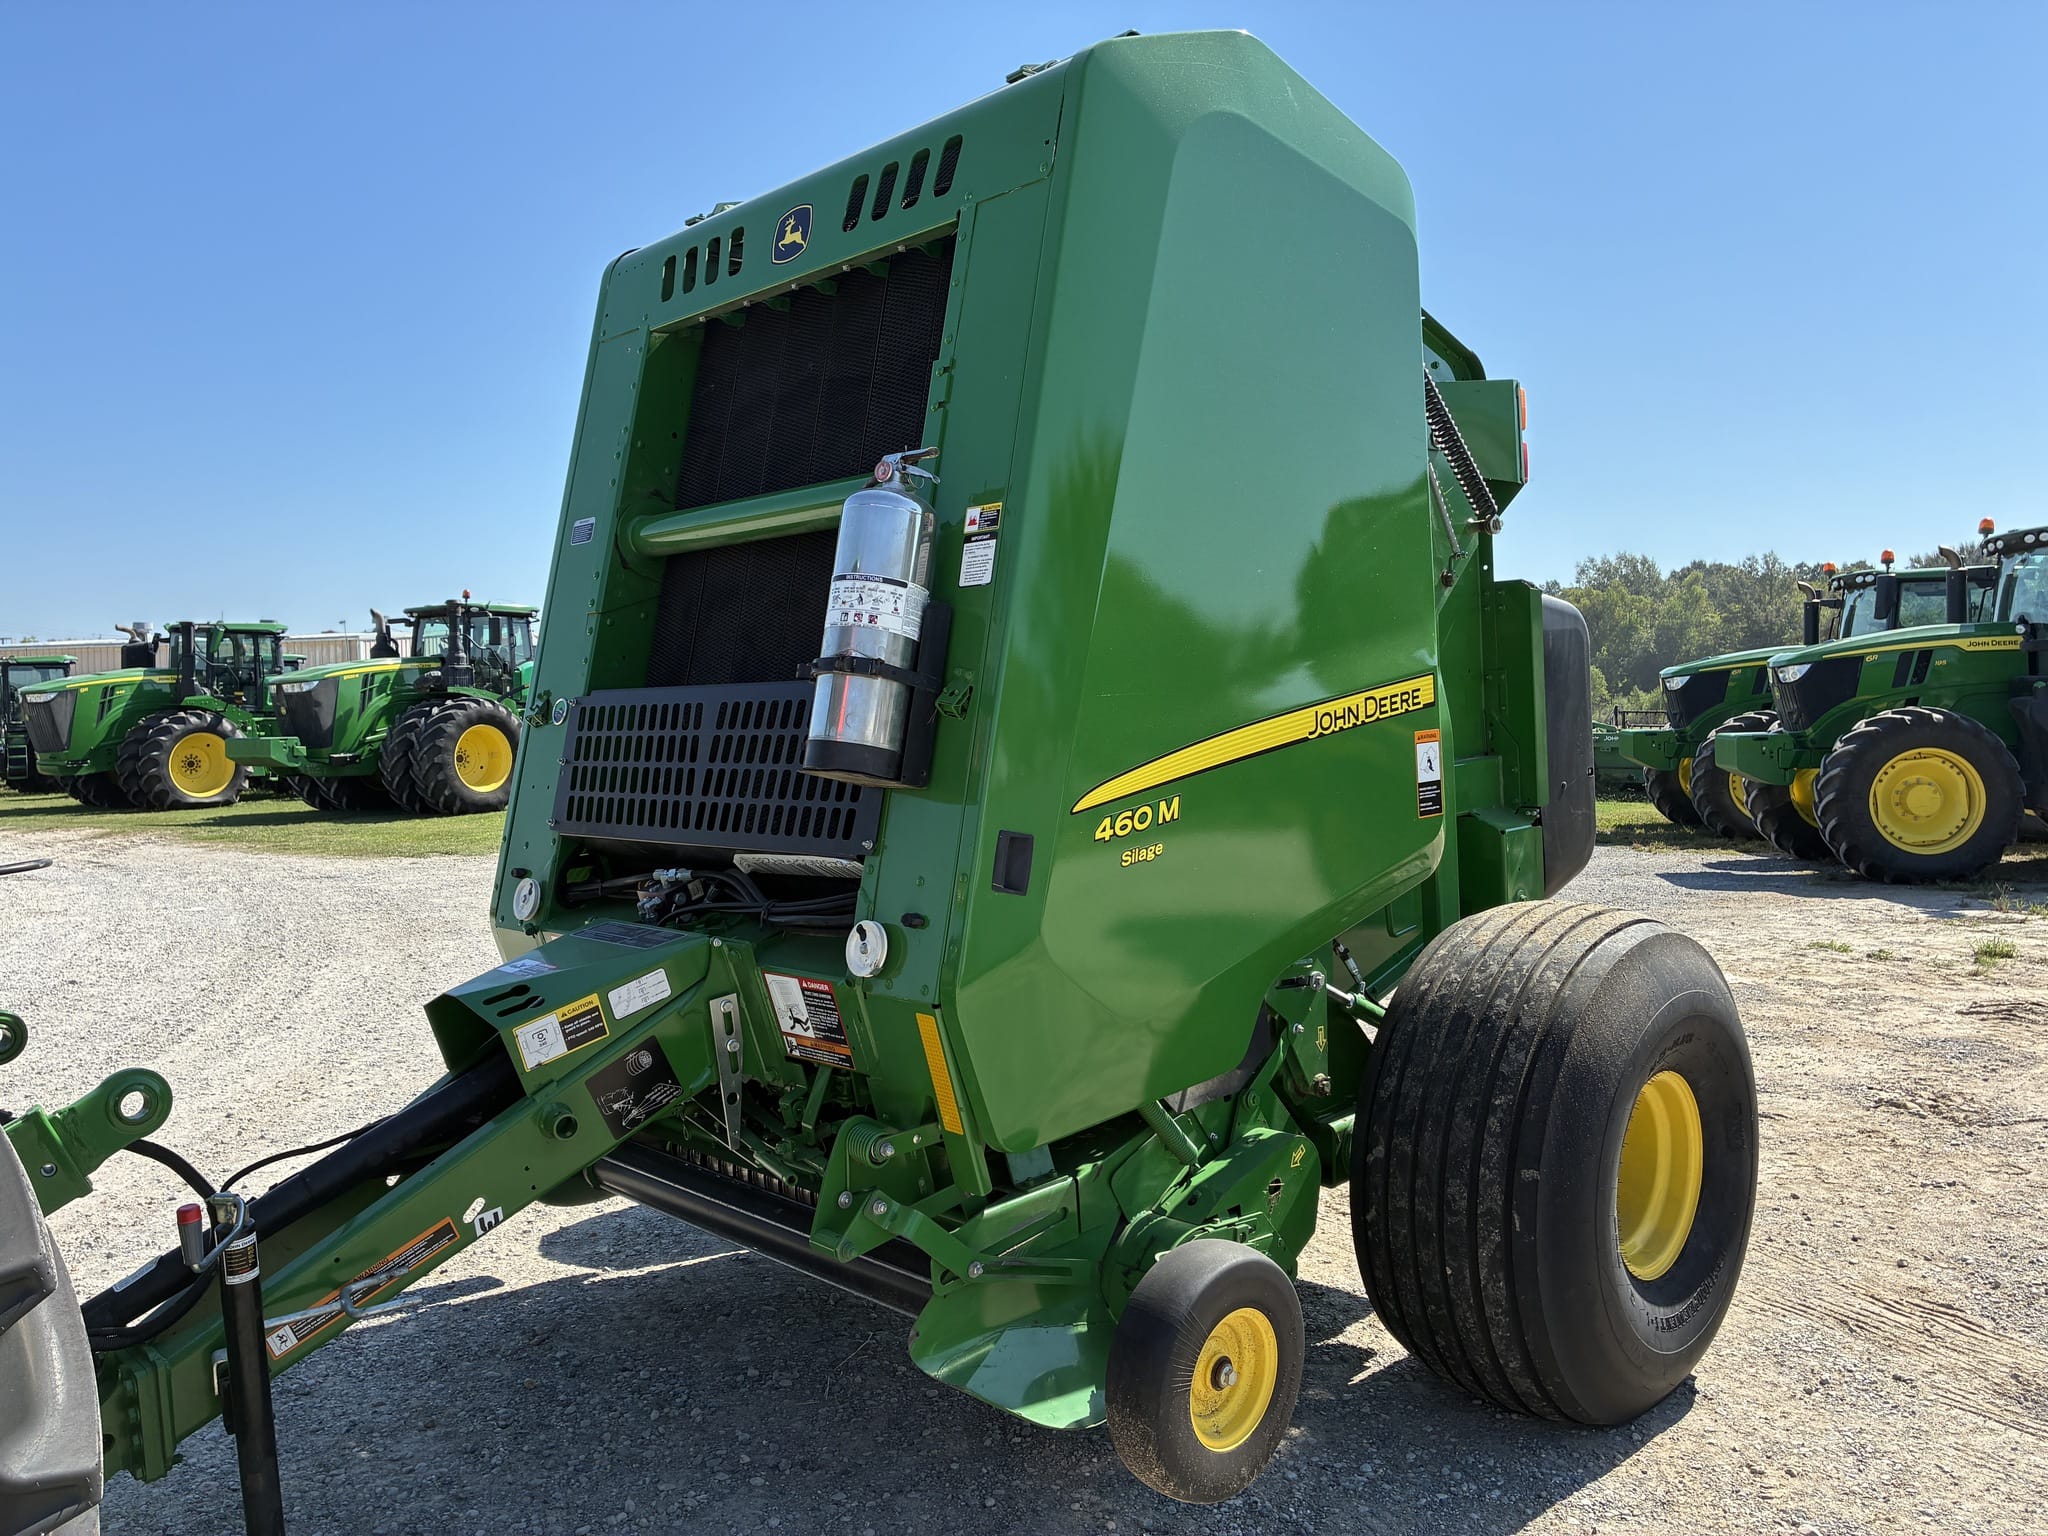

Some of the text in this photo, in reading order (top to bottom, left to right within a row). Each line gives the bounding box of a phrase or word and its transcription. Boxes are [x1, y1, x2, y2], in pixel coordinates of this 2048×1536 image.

[845, 574, 883, 583] INSTRUCTIONS
[1967, 639, 2019, 648] JOHN DEERE
[1865, 654, 1879, 662] 6R
[1308, 688, 1421, 735] JOHN DEERE
[1094, 796, 1180, 842] 460 M
[1121, 843, 1163, 867] Silage
[807, 982, 830, 992] DANGER
[567, 1000, 594, 1015] CAUTION
